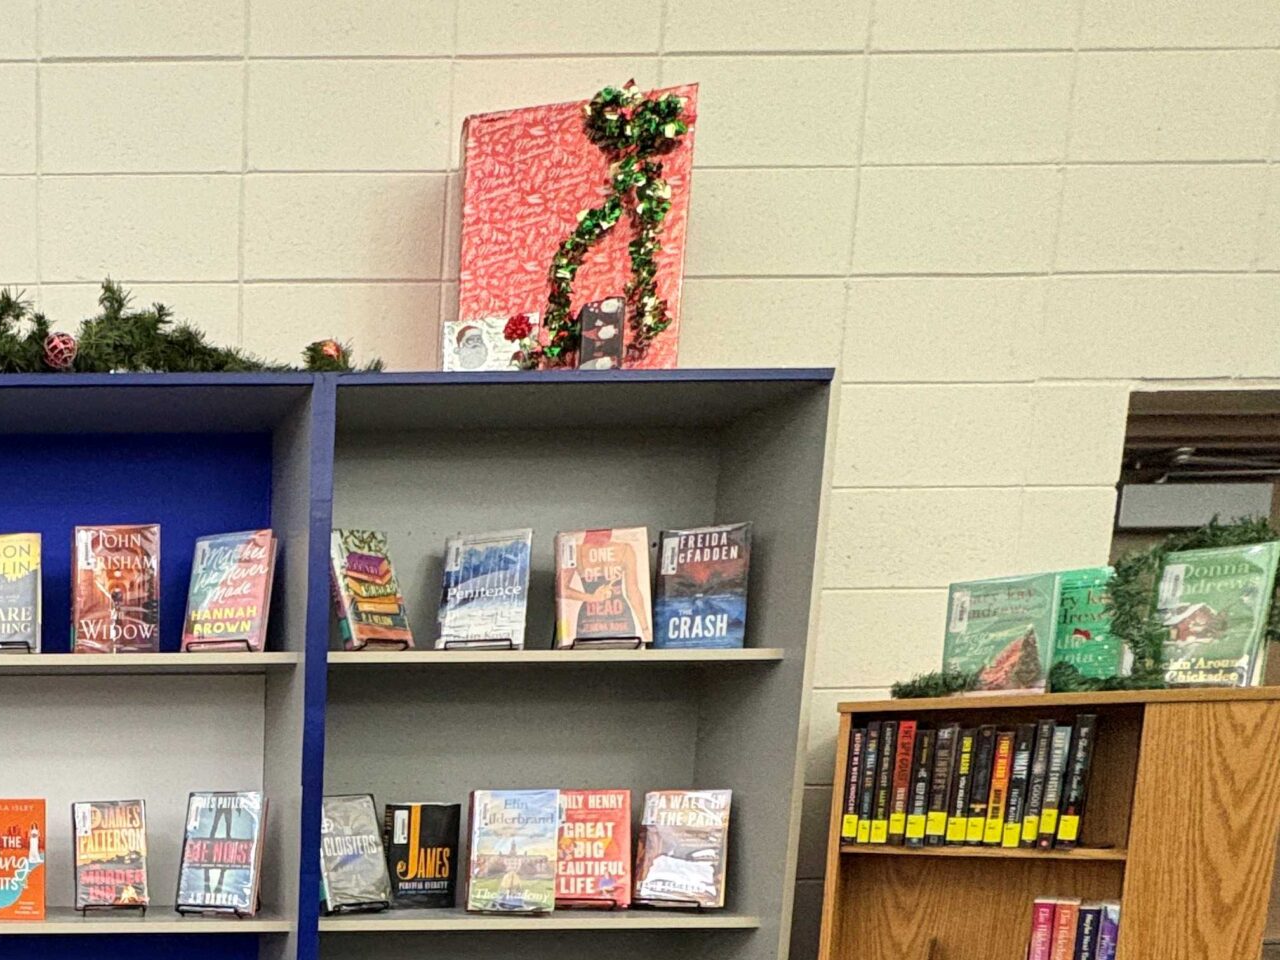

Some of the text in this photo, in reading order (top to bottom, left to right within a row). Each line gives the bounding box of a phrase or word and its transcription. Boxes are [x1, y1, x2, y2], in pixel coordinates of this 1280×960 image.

[98, 529, 141, 549] JOHN
[680, 531, 728, 550] FREIDA
[588, 547, 615, 563] ONE
[220, 565, 269, 583] Never
[584, 566, 623, 583] OF US
[204, 581, 251, 606] Made
[447, 584, 522, 601] Penitence
[191, 605, 258, 622] HANNAH
[586, 599, 623, 616] DEAD
[678, 608, 693, 617] THE
[79, 619, 156, 640] WIDOW
[193, 620, 251, 636] BROWN
[668, 614, 729, 640] CRASH
[1012, 751, 1030, 780] INMATE
[503, 798, 528, 810] Elin
[588, 794, 624, 809] HENRY
[658, 794, 667, 809] A
[1029, 784, 1041, 807] GOOD
[102, 805, 141, 829] JAMES
[659, 811, 684, 826] THE
[564, 821, 615, 839] GREAT
[2, 835, 22, 848] THE
[78, 828, 146, 854] PATTERSON
[323, 834, 378, 857] CLOISTERS
[396, 803, 451, 880] JAMES
[573, 841, 605, 859] BIG
[474, 889, 495, 899] The
[559, 876, 596, 894] LIFE
